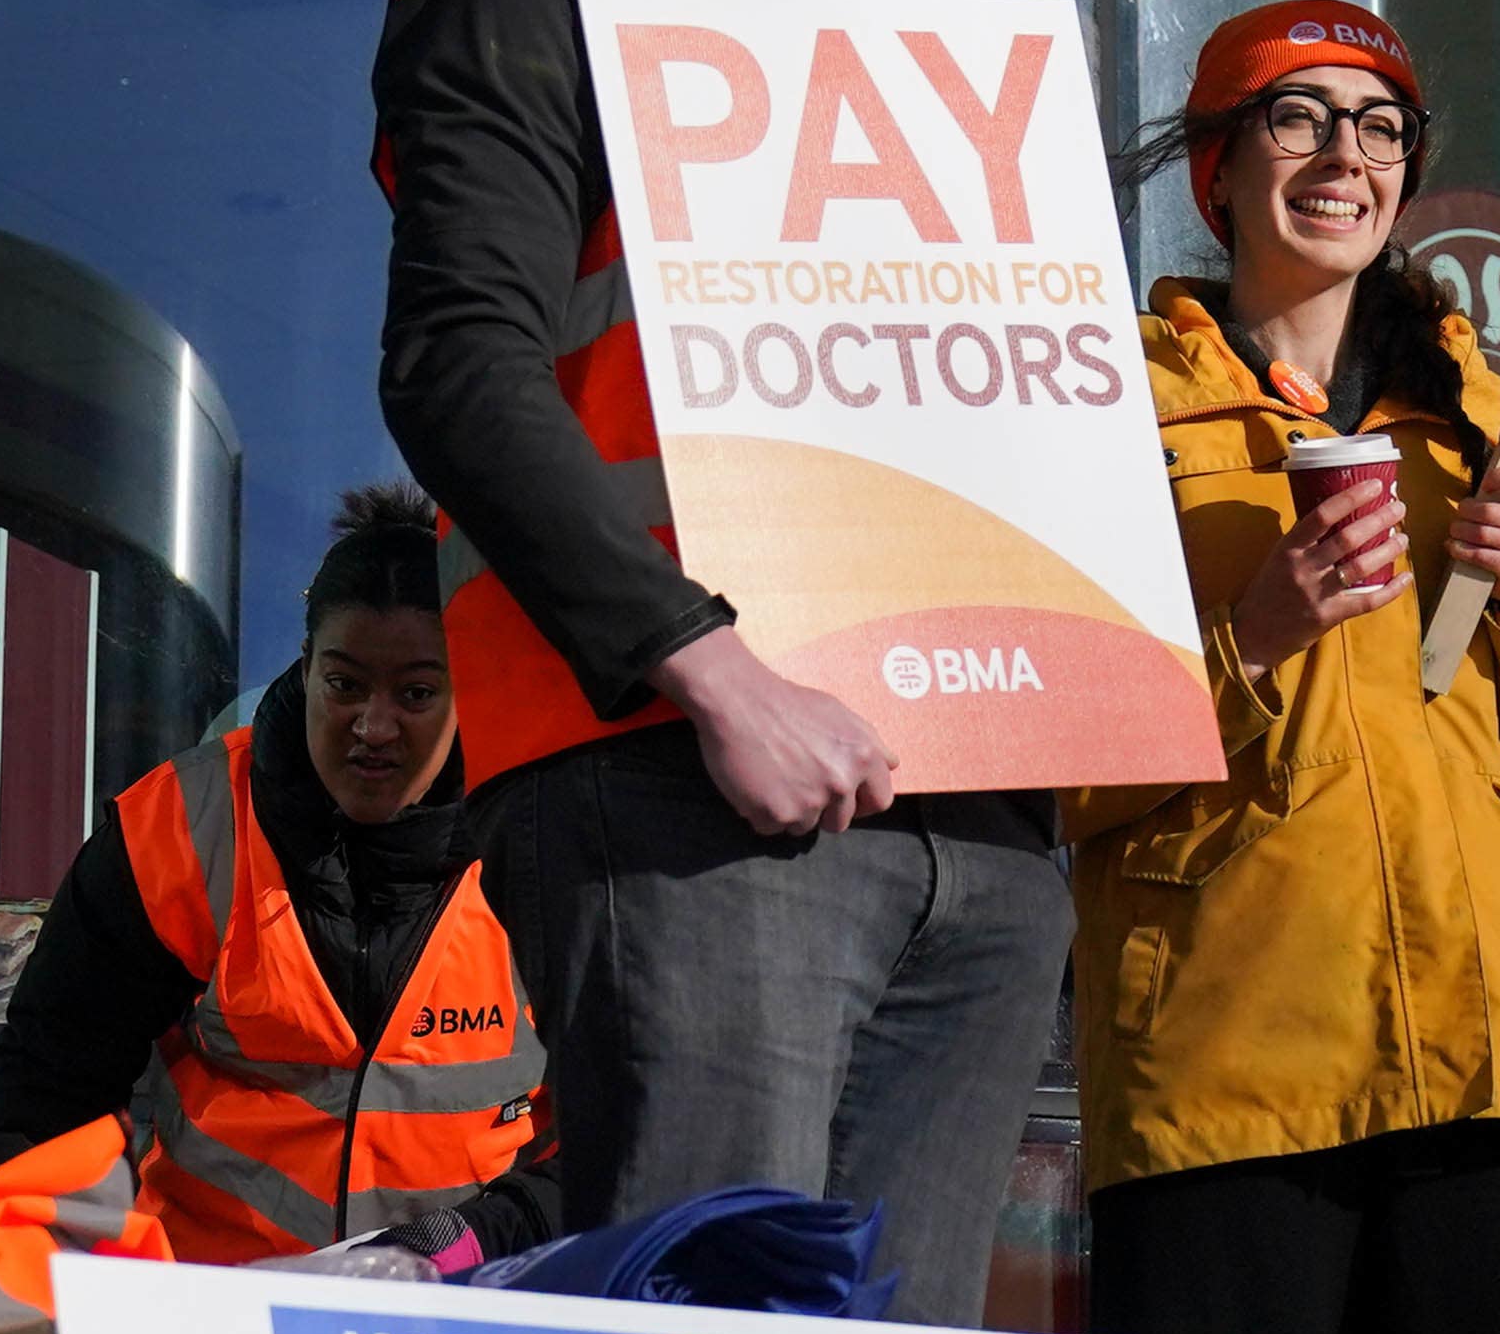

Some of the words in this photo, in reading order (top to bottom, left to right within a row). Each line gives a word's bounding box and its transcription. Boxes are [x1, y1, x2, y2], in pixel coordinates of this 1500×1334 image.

[1333, 23, 1405, 64] BMA
[615, 23, 1055, 244] PAY
[658, 260, 1002, 306] RESTORATION
[1014, 261, 1108, 306] FOR
[672, 322, 1125, 408] DOCTORS
[934, 646, 1044, 695] BMA
[440, 1004, 504, 1035] BMA
